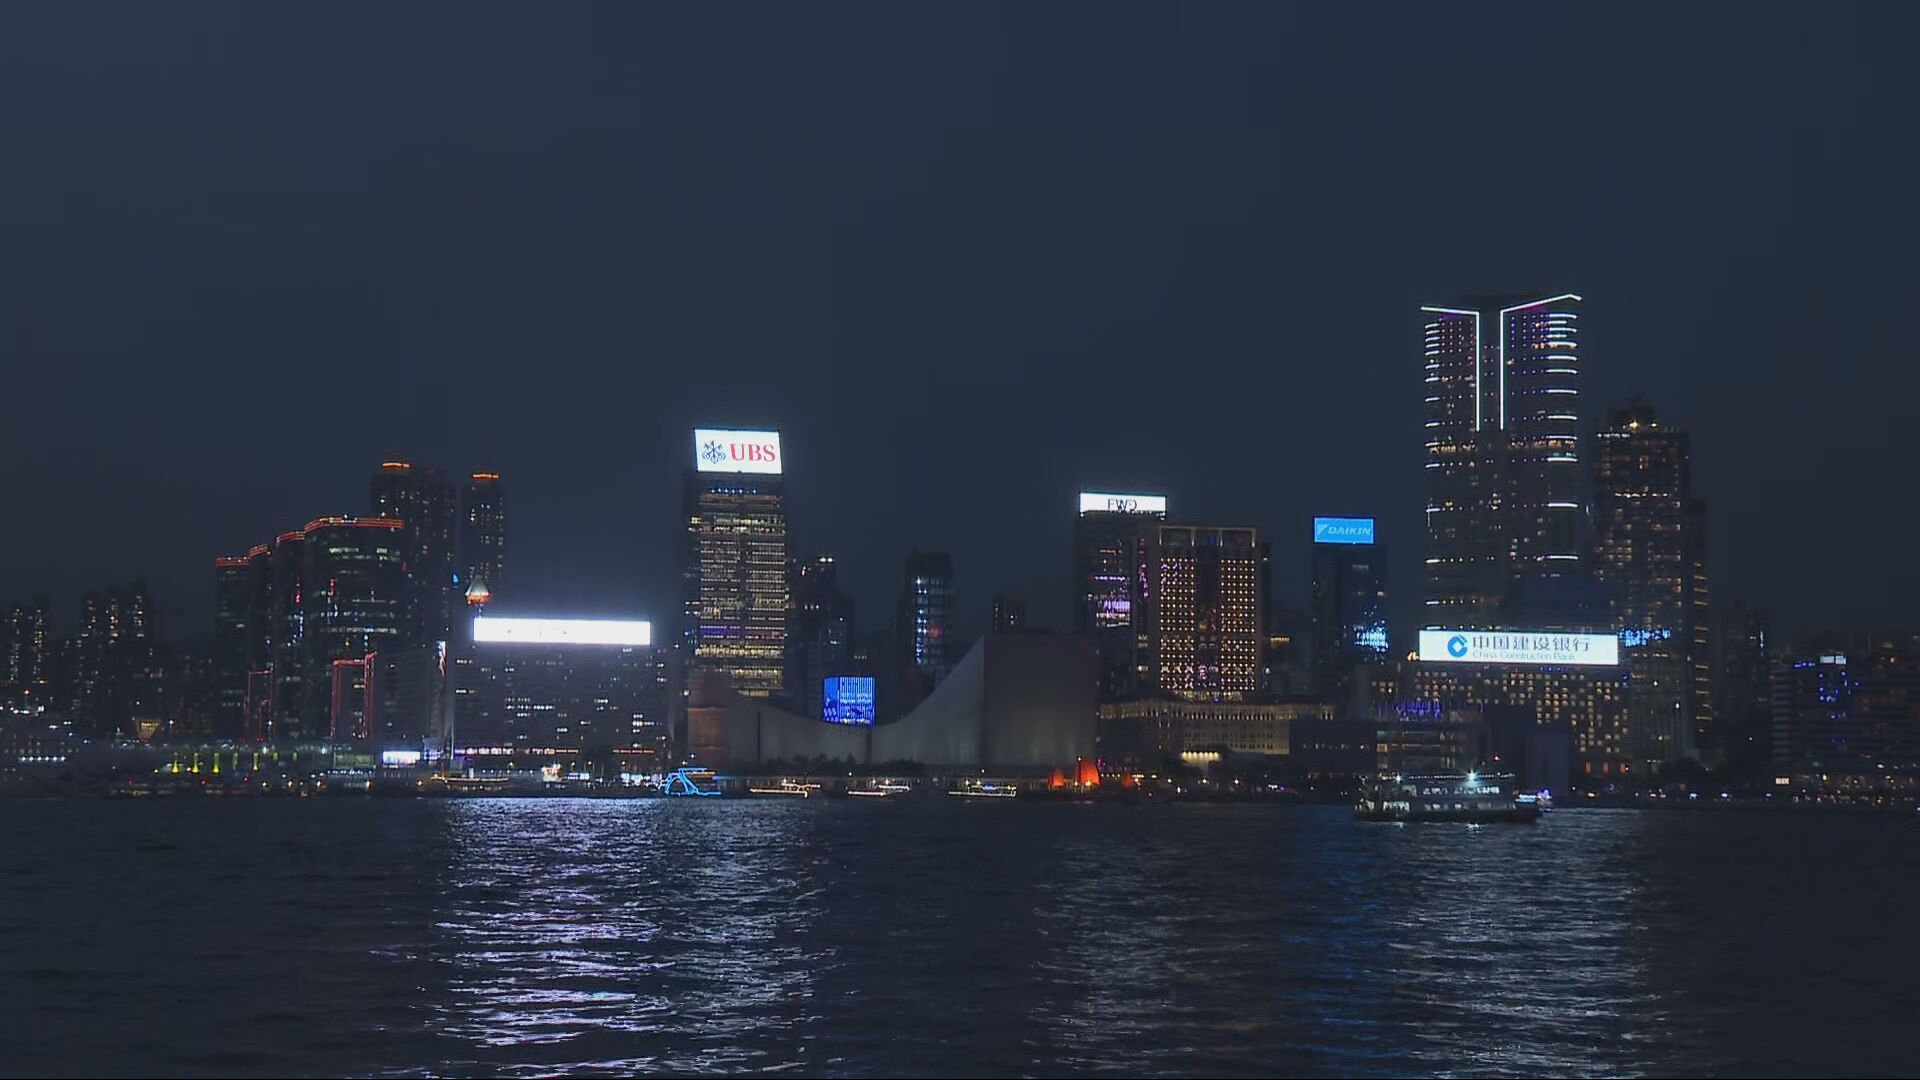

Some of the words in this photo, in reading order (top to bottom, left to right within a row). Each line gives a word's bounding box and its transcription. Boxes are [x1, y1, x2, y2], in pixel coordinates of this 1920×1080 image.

[730, 443, 776, 462] UBS
[1107, 498, 1138, 512] FWD
[1328, 526, 1371, 536] DAIKIN
[1473, 635, 1590, 651] 中国建设银行
[1473, 650, 1497, 658] China
[1500, 651, 1551, 659] Construction
[1554, 652, 1575, 661] Bank
